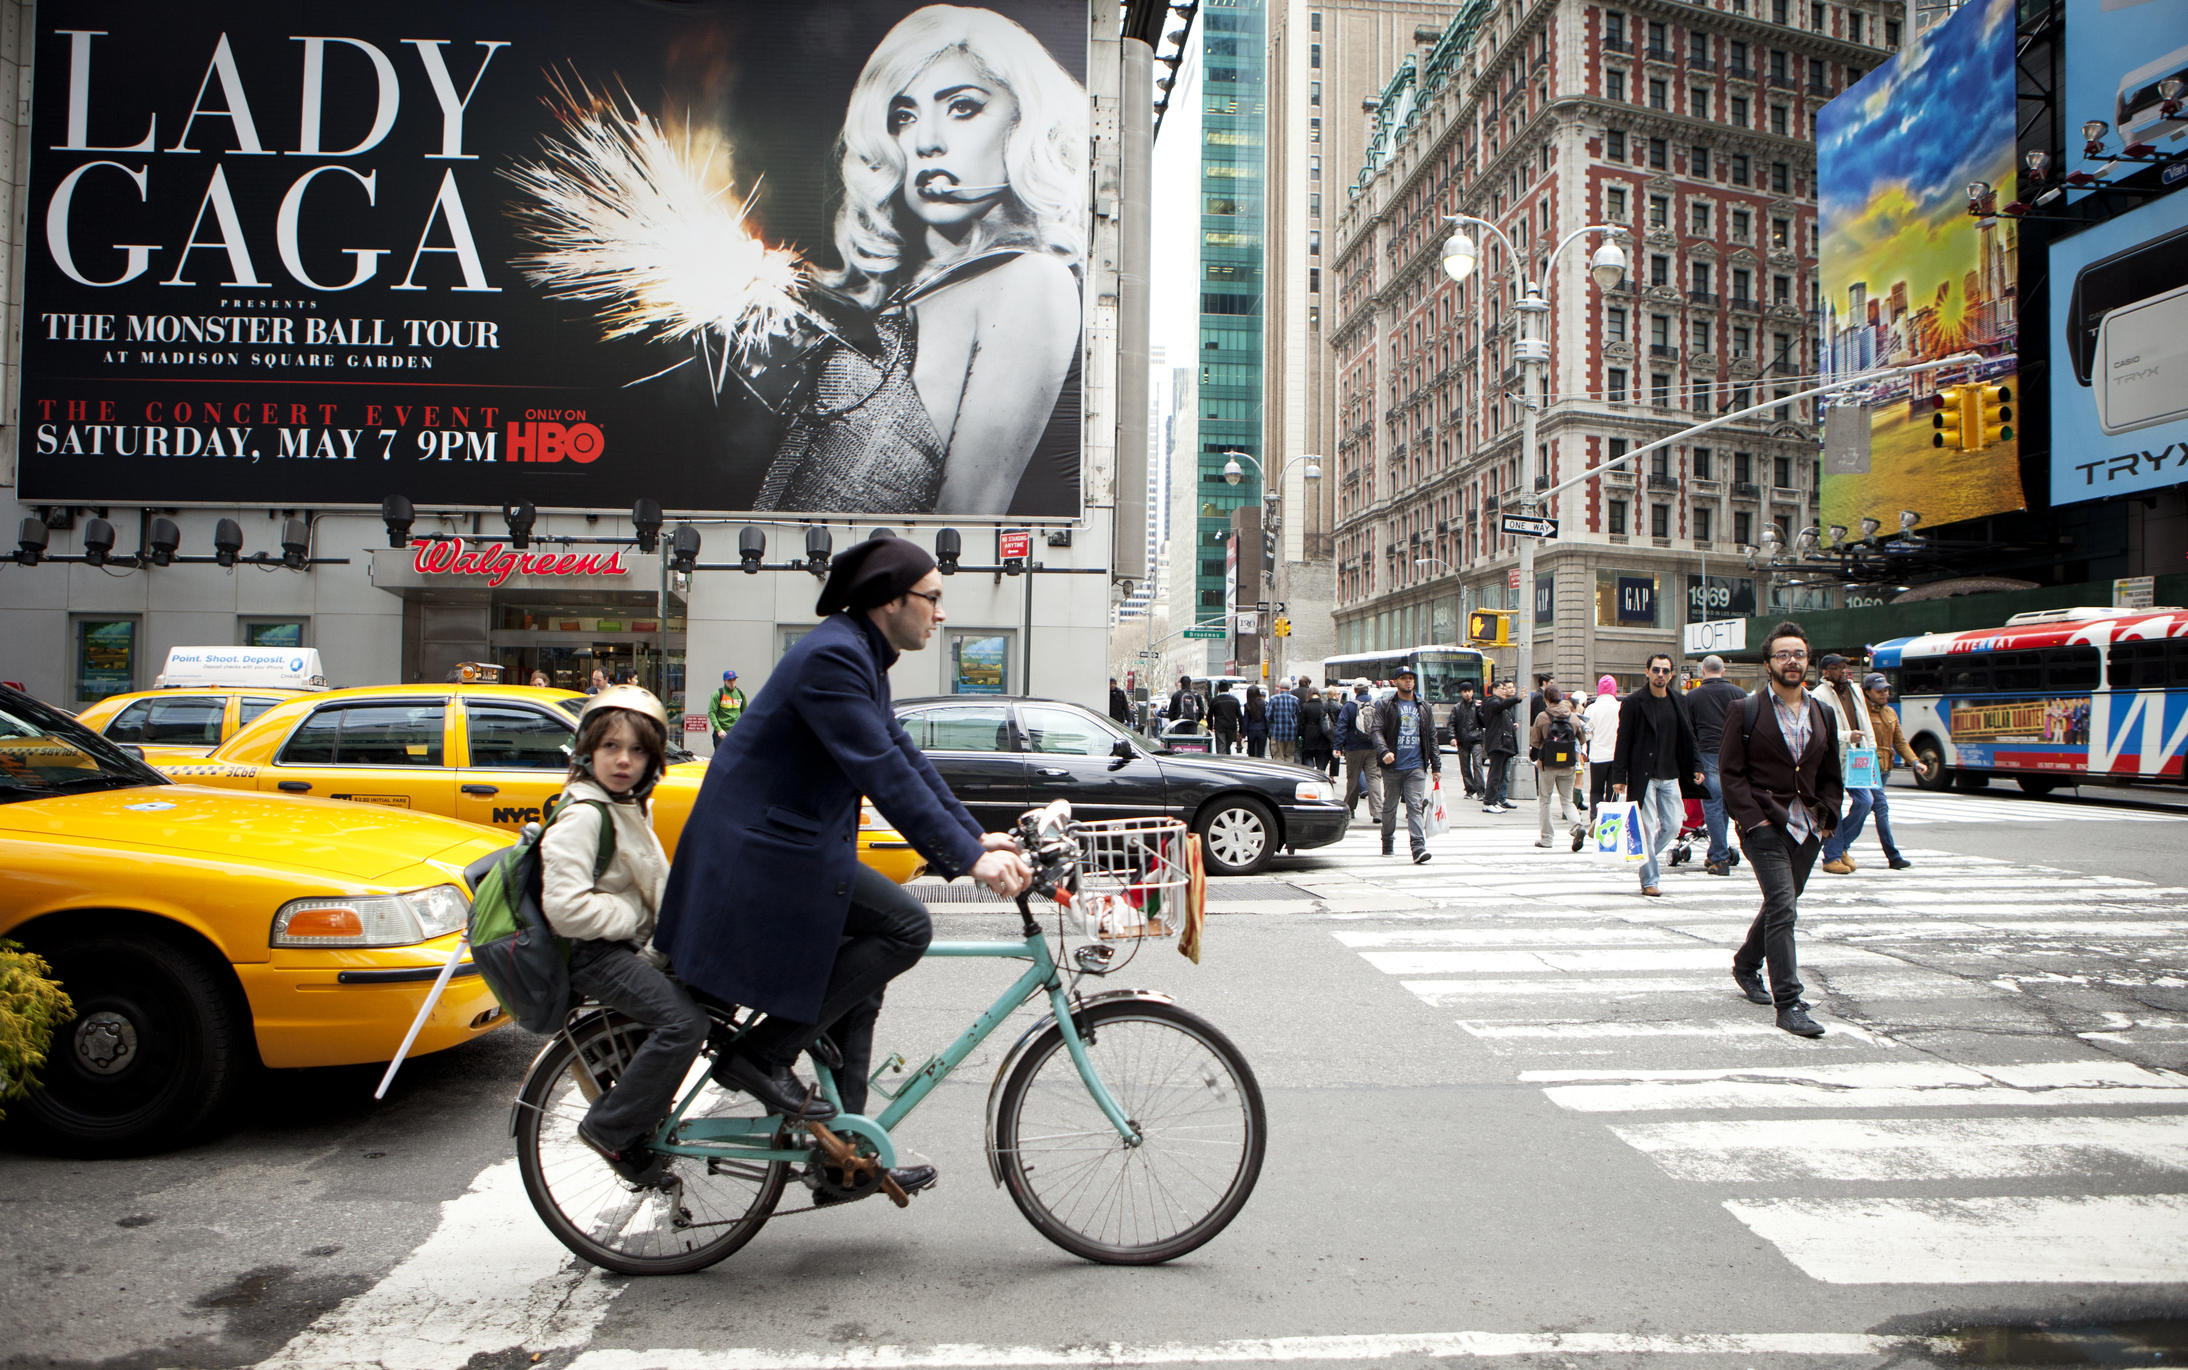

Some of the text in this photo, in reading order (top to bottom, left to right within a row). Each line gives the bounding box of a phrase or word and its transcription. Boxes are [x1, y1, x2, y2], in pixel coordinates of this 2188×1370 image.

[50, 30, 511, 159] LADY
[46, 161, 502, 292] GAGA
[220, 299, 317, 309] PRESENTS
[41, 313, 500, 349] THE MONSTER BALL TOUR
[103, 351, 433, 369] AT MADISON SQUARE GARDEN
[2113, 355, 2140, 369] CASIO
[2113, 365, 2159, 386] TRYX
[38, 399, 499, 428] THE CONCERT EVENT
[525, 408, 587, 421] ONLY ON
[36, 423, 499, 464] SATURDAY, MAY 7 9PM
[505, 421, 605, 464] HBO
[1509, 520, 1550, 533] ONE WAY
[410, 537, 630, 588] Walgreens
[1537, 587, 1549, 613] GAP
[1625, 586, 1650, 612] GAP
[1688, 585, 1731, 608] 1969
[1692, 621, 1737, 650] LOFT
[171, 655, 285, 664] Point. Shoot. Deposit.
[226, 767, 258, 778] 3C68
[493, 807, 540, 823] NYC
